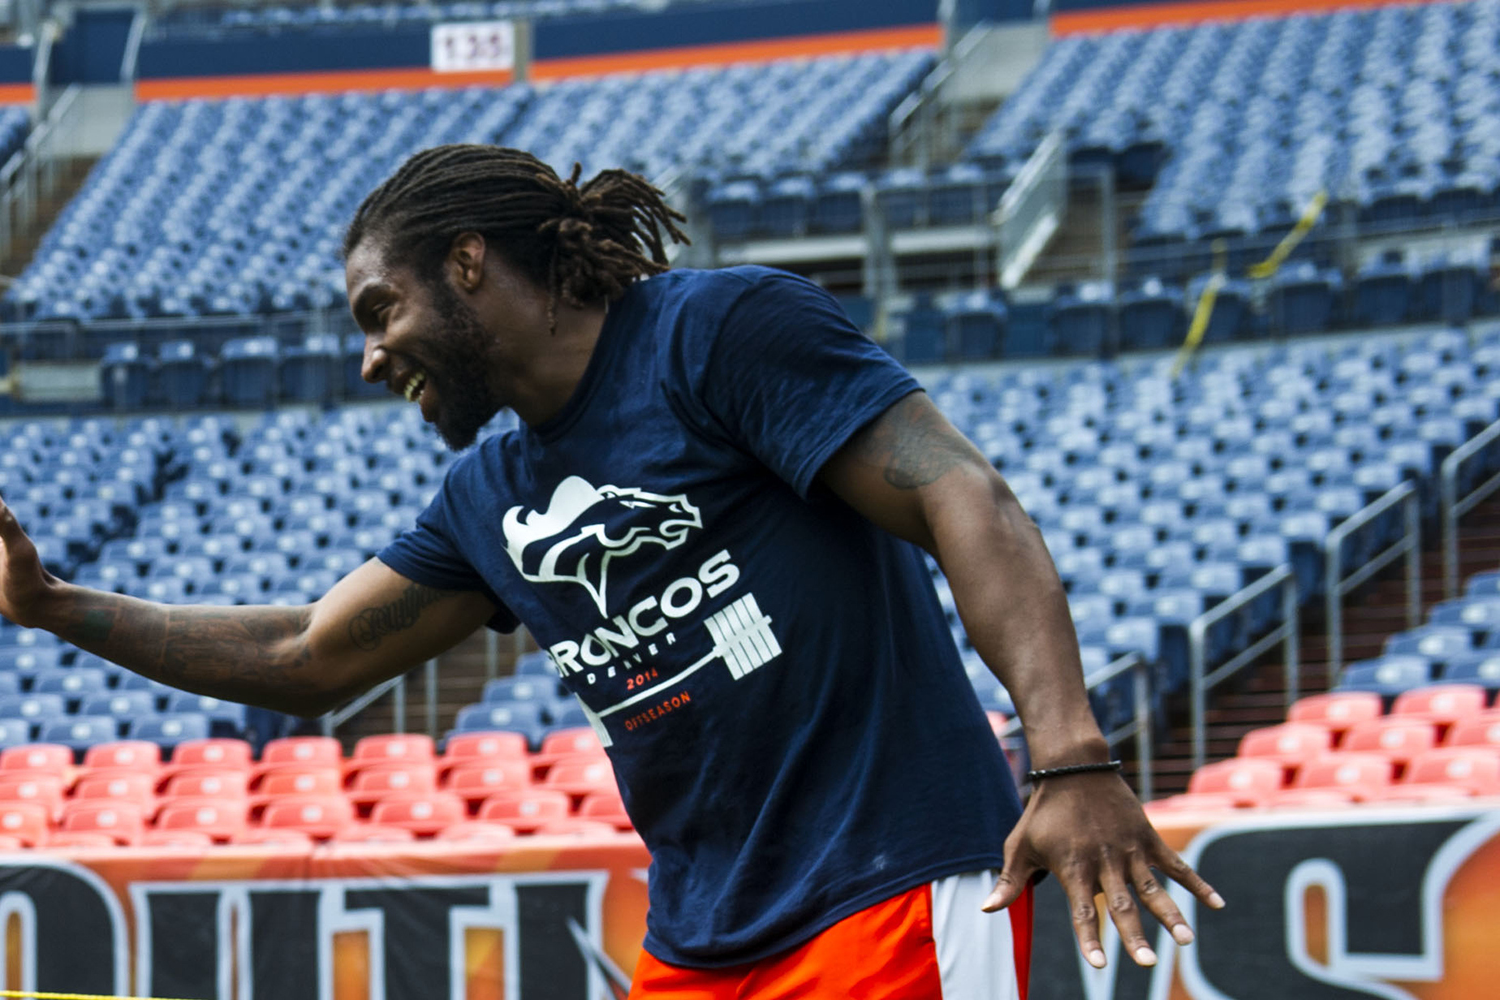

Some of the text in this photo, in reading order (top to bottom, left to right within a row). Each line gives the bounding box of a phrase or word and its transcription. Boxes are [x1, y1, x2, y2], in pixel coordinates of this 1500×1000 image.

[545, 549, 740, 679] RONCOS
[586, 632, 677, 685] DENVER
[626, 667, 659, 691] 2014
[624, 690, 692, 732] OFFSEASON
